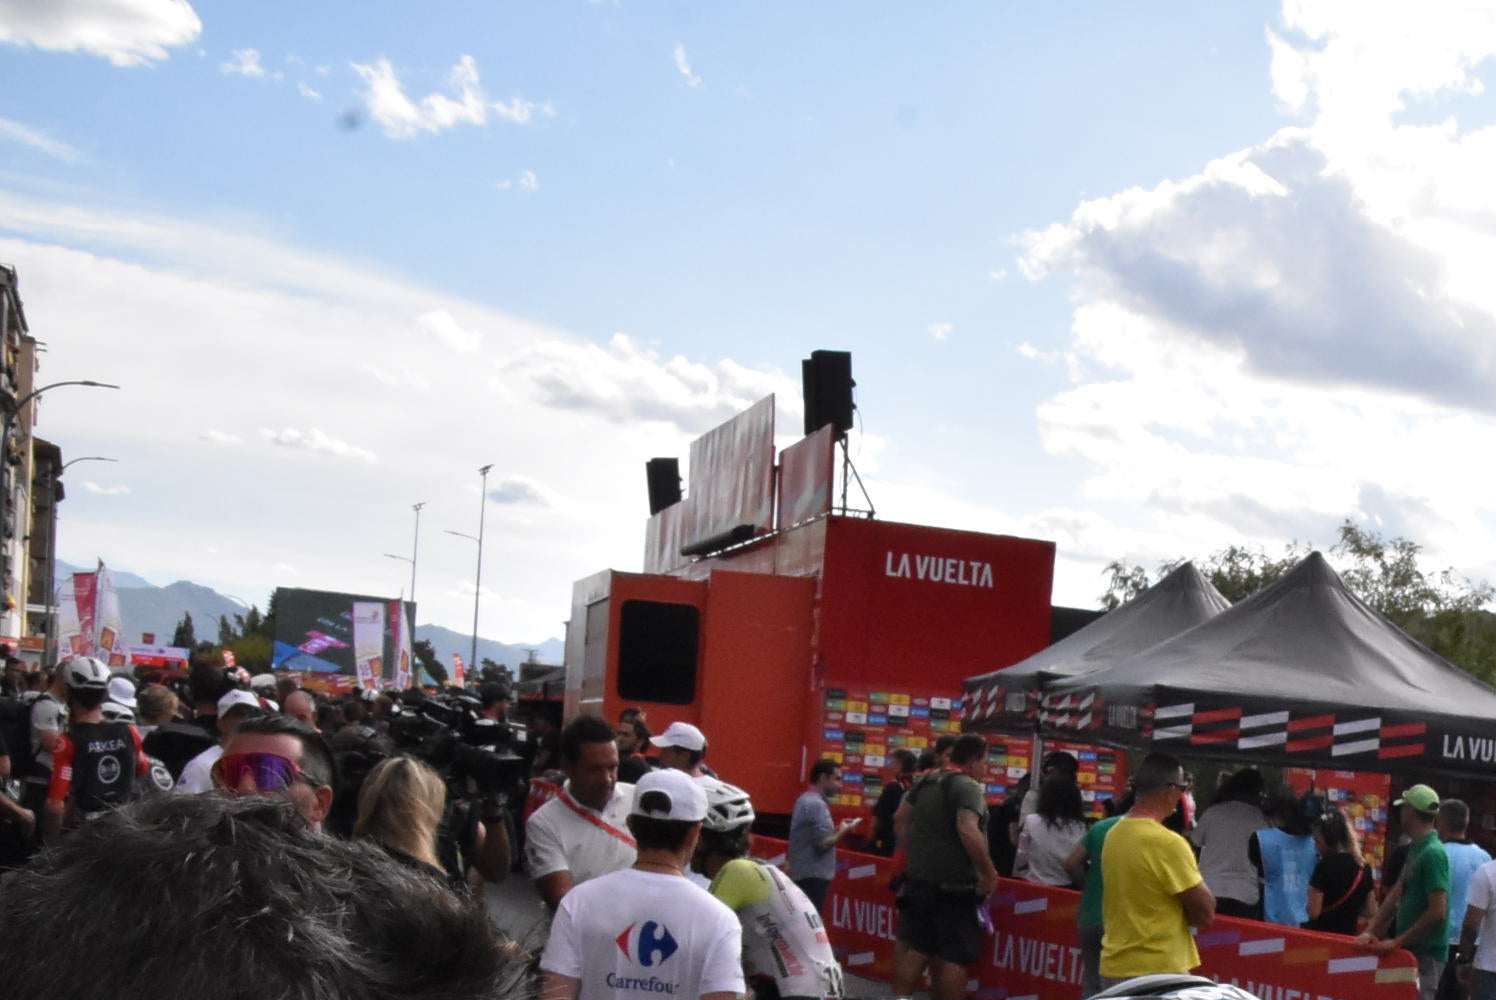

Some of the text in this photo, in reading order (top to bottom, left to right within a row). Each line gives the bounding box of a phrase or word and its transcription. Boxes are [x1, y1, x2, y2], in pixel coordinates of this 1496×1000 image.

[885, 551, 994, 588] LA VUELTA
[1442, 734, 1464, 759] LA
[833, 894, 898, 941] LA VUEL
[993, 931, 1014, 971] LA
[606, 972, 680, 994] Carrefour
